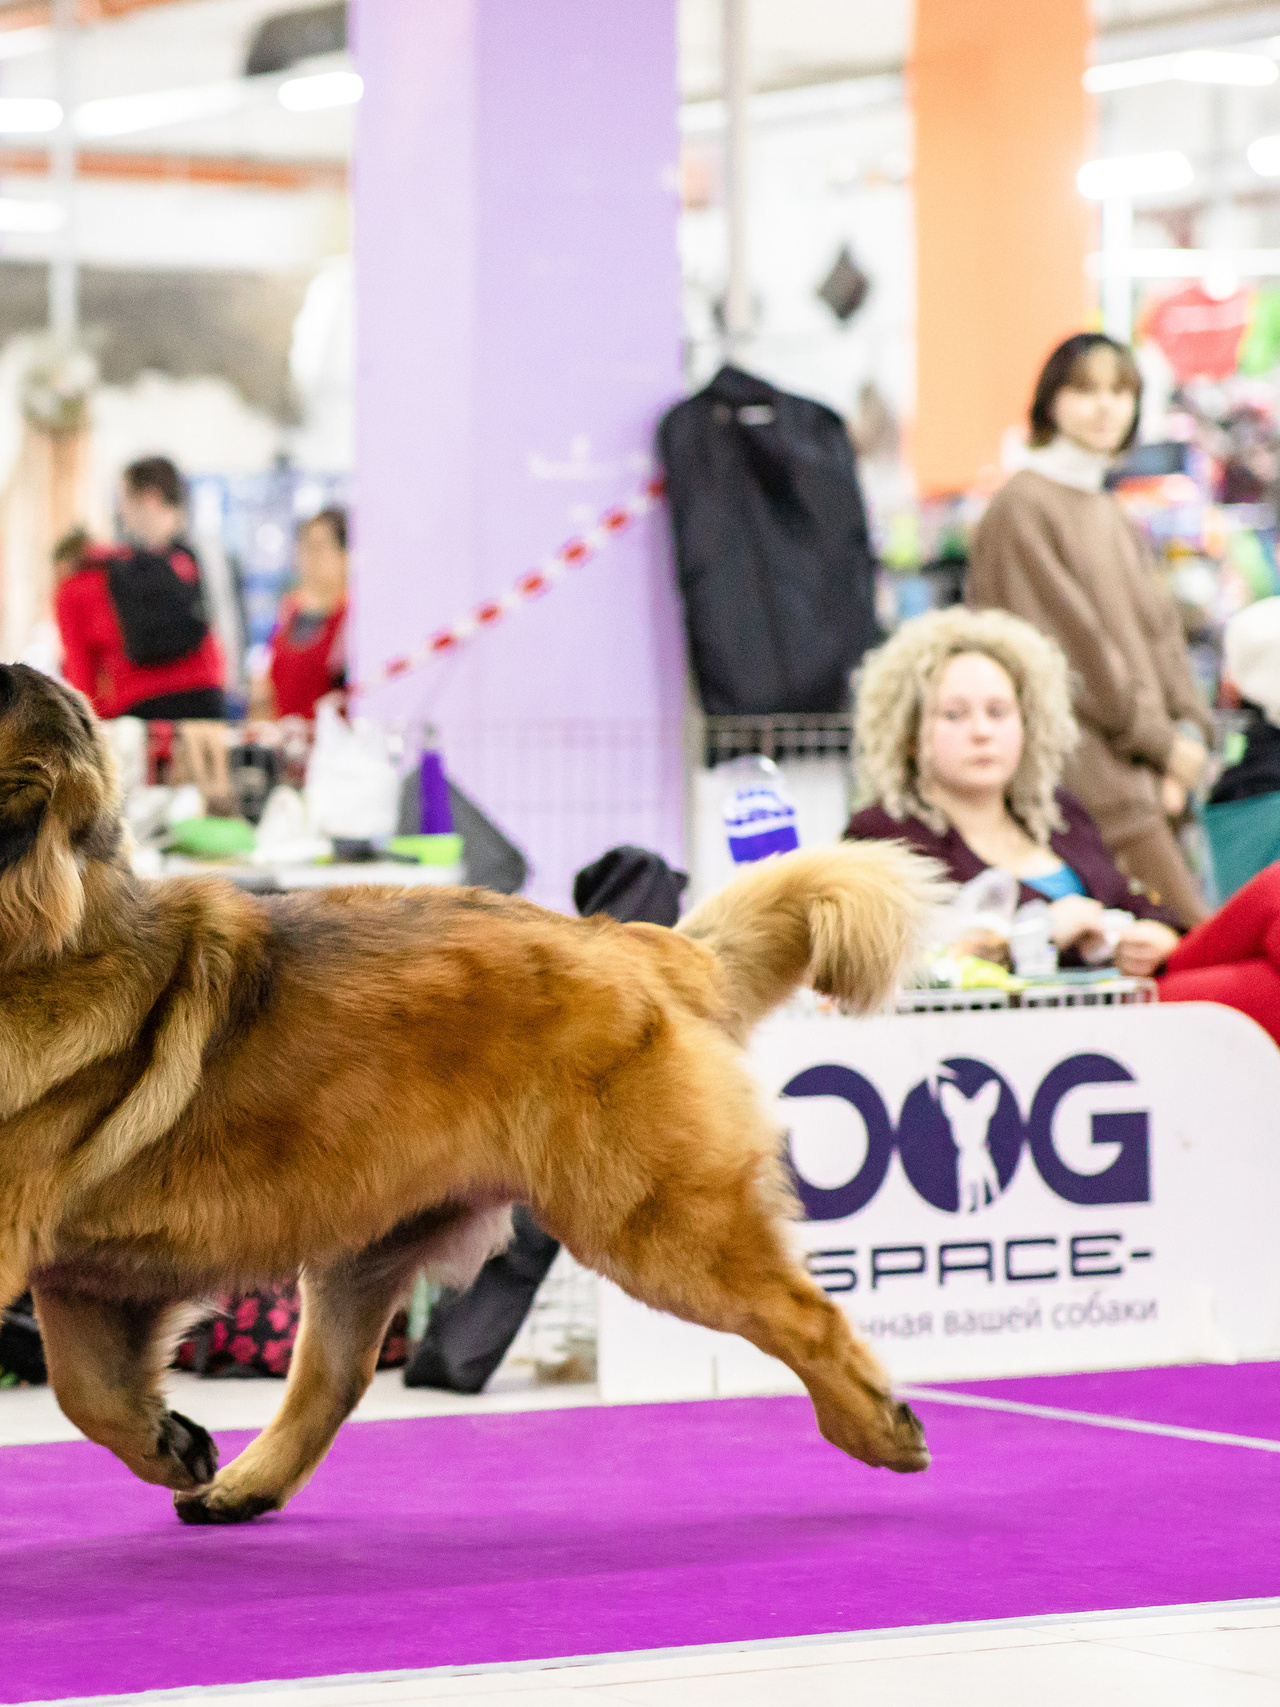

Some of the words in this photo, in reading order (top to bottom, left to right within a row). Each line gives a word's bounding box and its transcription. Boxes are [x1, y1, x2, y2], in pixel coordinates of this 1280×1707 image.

[778, 1052, 1151, 1222] DOG
[942, 1297, 1042, 1337] вашей
[1050, 1288, 1159, 1331] собаки
